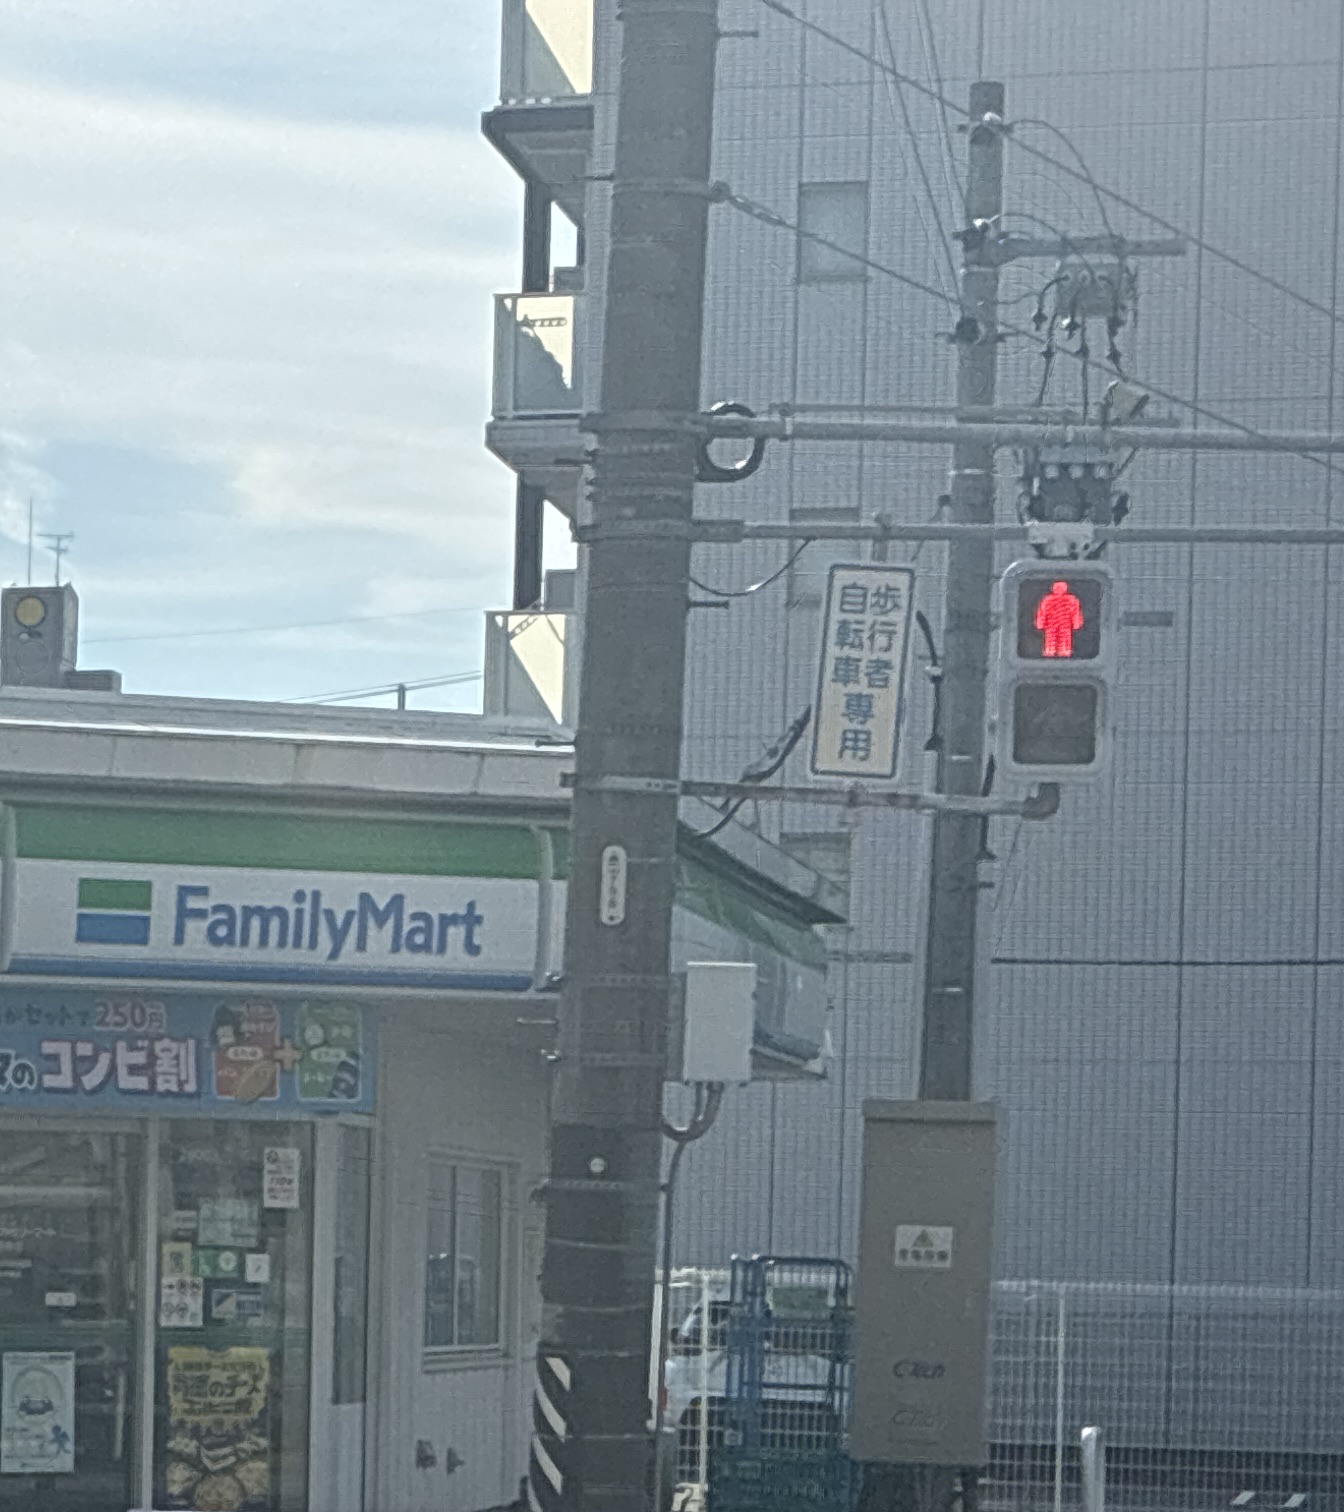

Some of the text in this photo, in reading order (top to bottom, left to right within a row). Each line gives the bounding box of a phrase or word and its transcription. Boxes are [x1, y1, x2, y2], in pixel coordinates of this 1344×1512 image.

[830, 581, 869, 688] 自転車
[864, 582, 902, 689] 歩行者
[838, 692, 875, 762] 専用
[173, 884, 484, 961] FamilyMart
